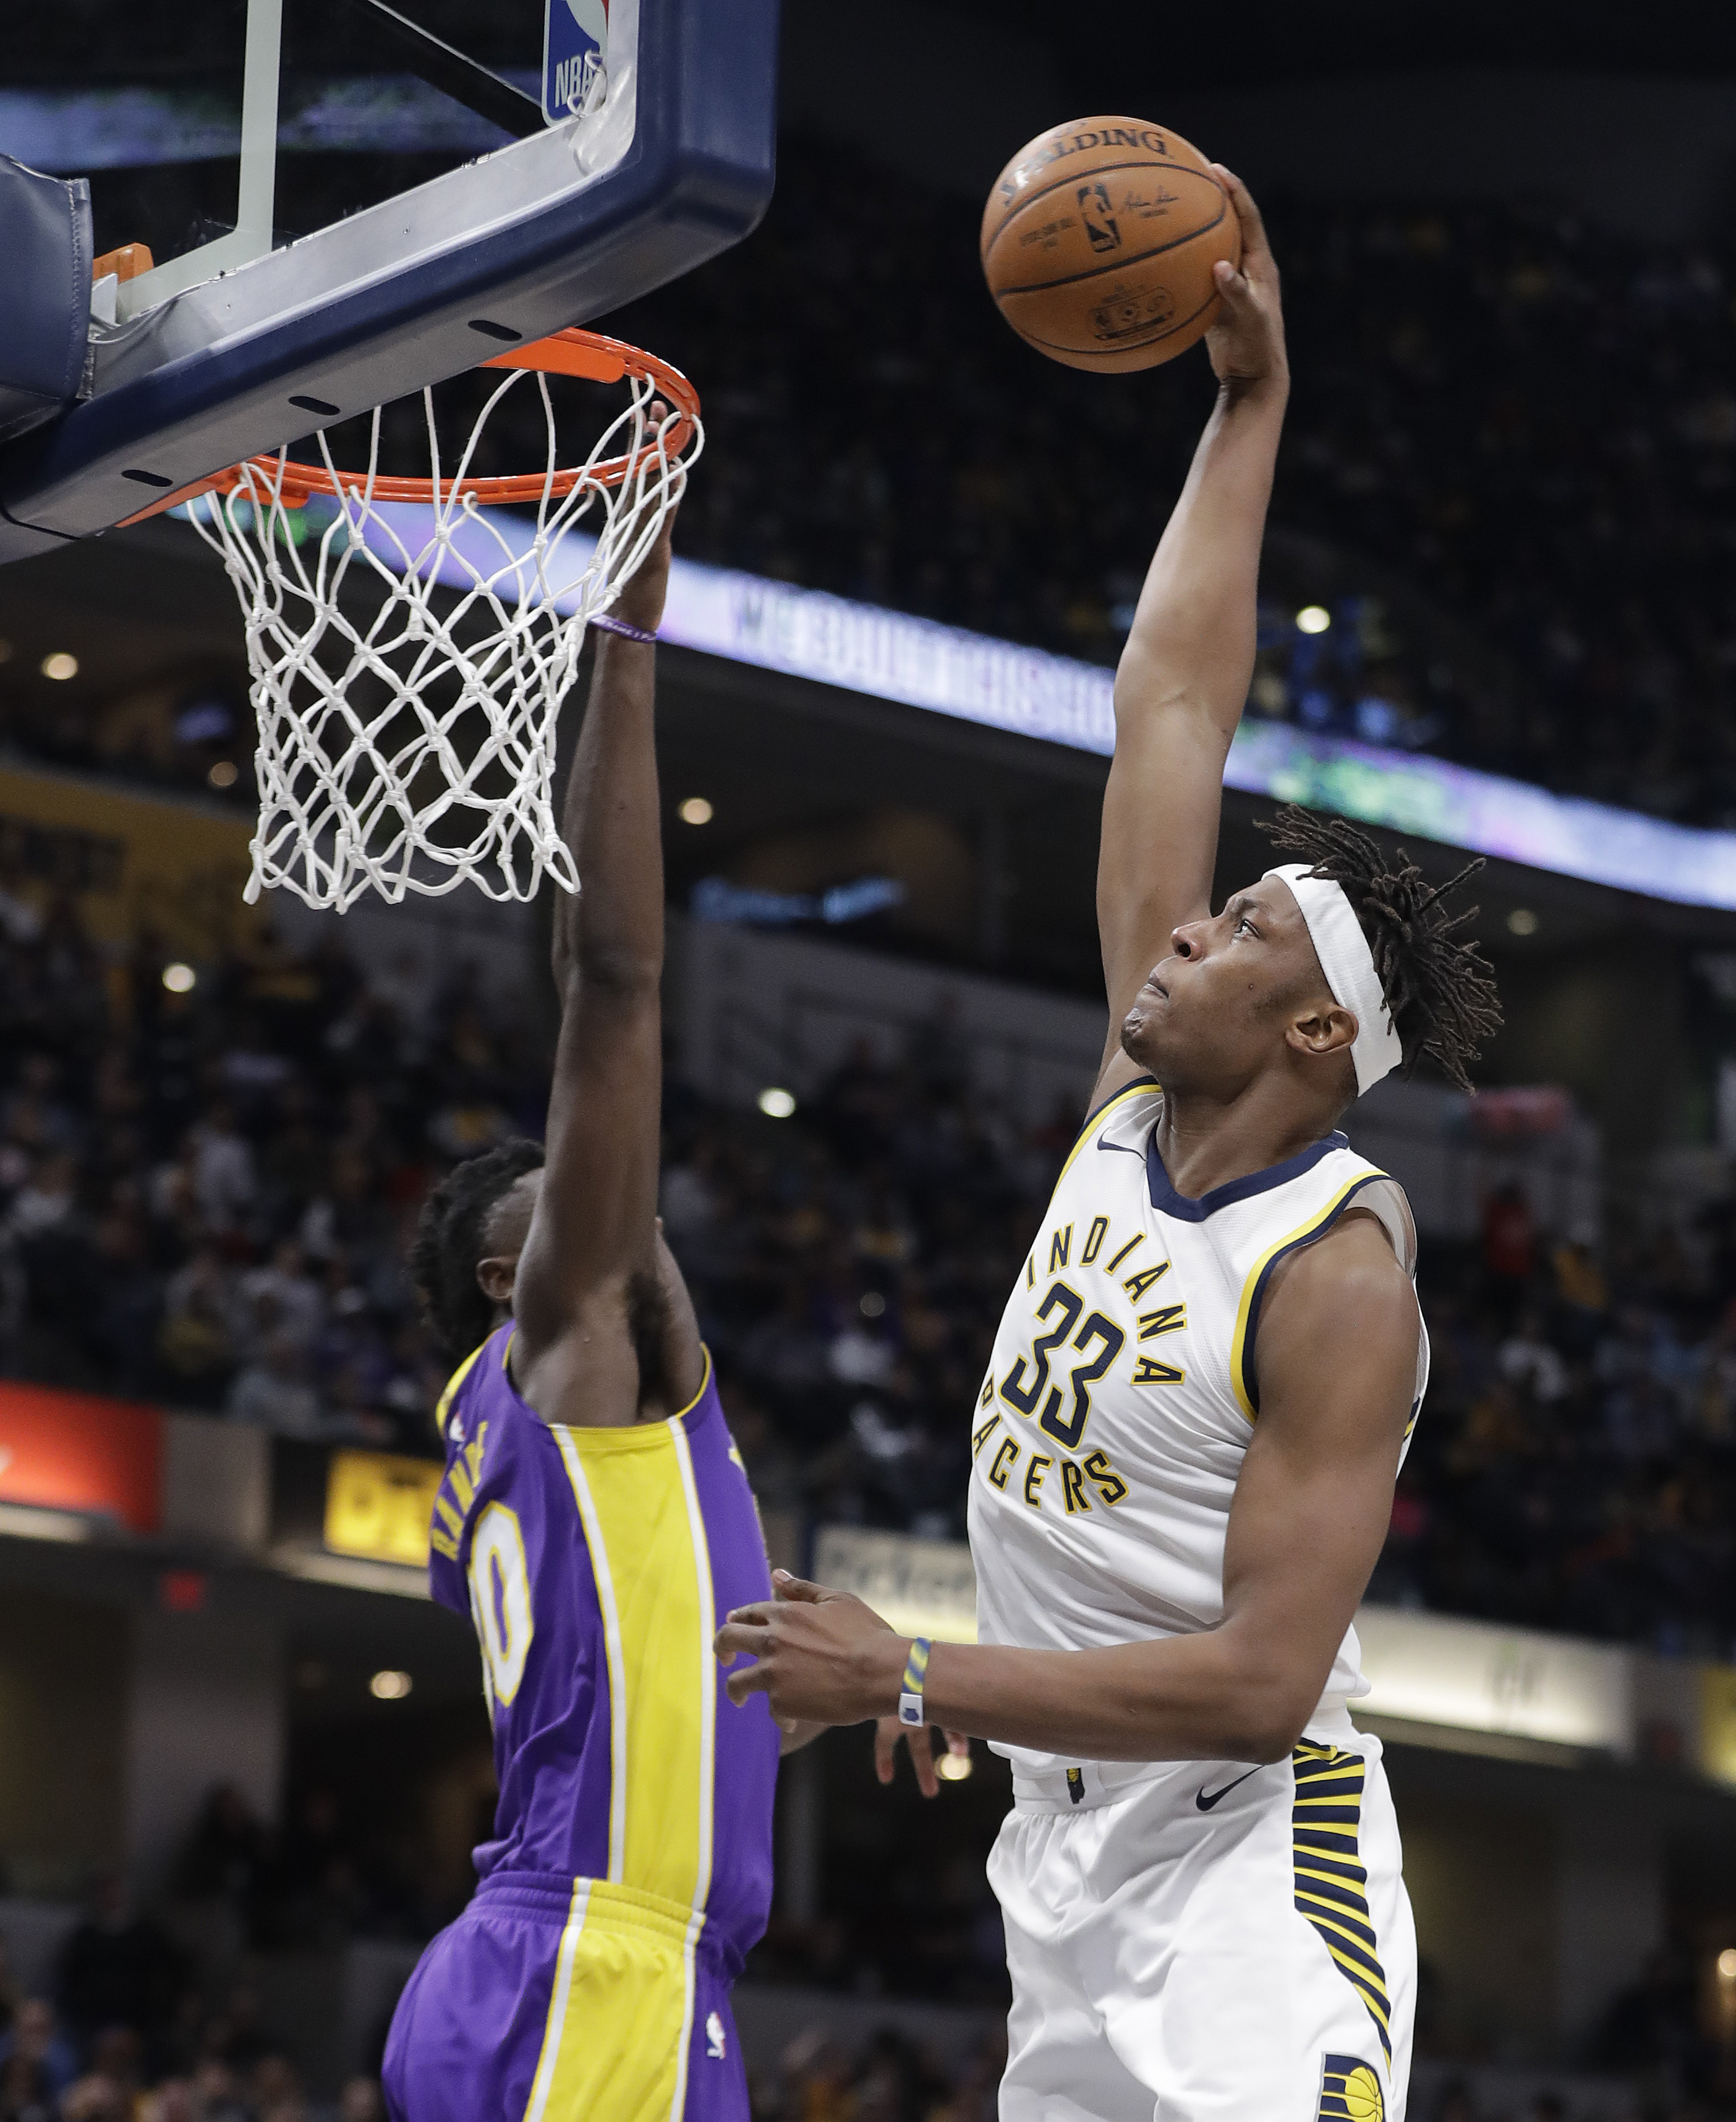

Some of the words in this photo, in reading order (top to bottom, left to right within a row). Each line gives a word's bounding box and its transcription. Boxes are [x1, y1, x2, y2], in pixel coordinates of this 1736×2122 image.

[555, 55, 595, 108] NBA
[1000, 129, 1168, 207] SLDING
[998, 1279, 1126, 1451] 33
[1027, 1215, 1187, 1386] INDIANA
[972, 1373, 1130, 1515] PACERS
[467, 1501, 534, 1722] 0
